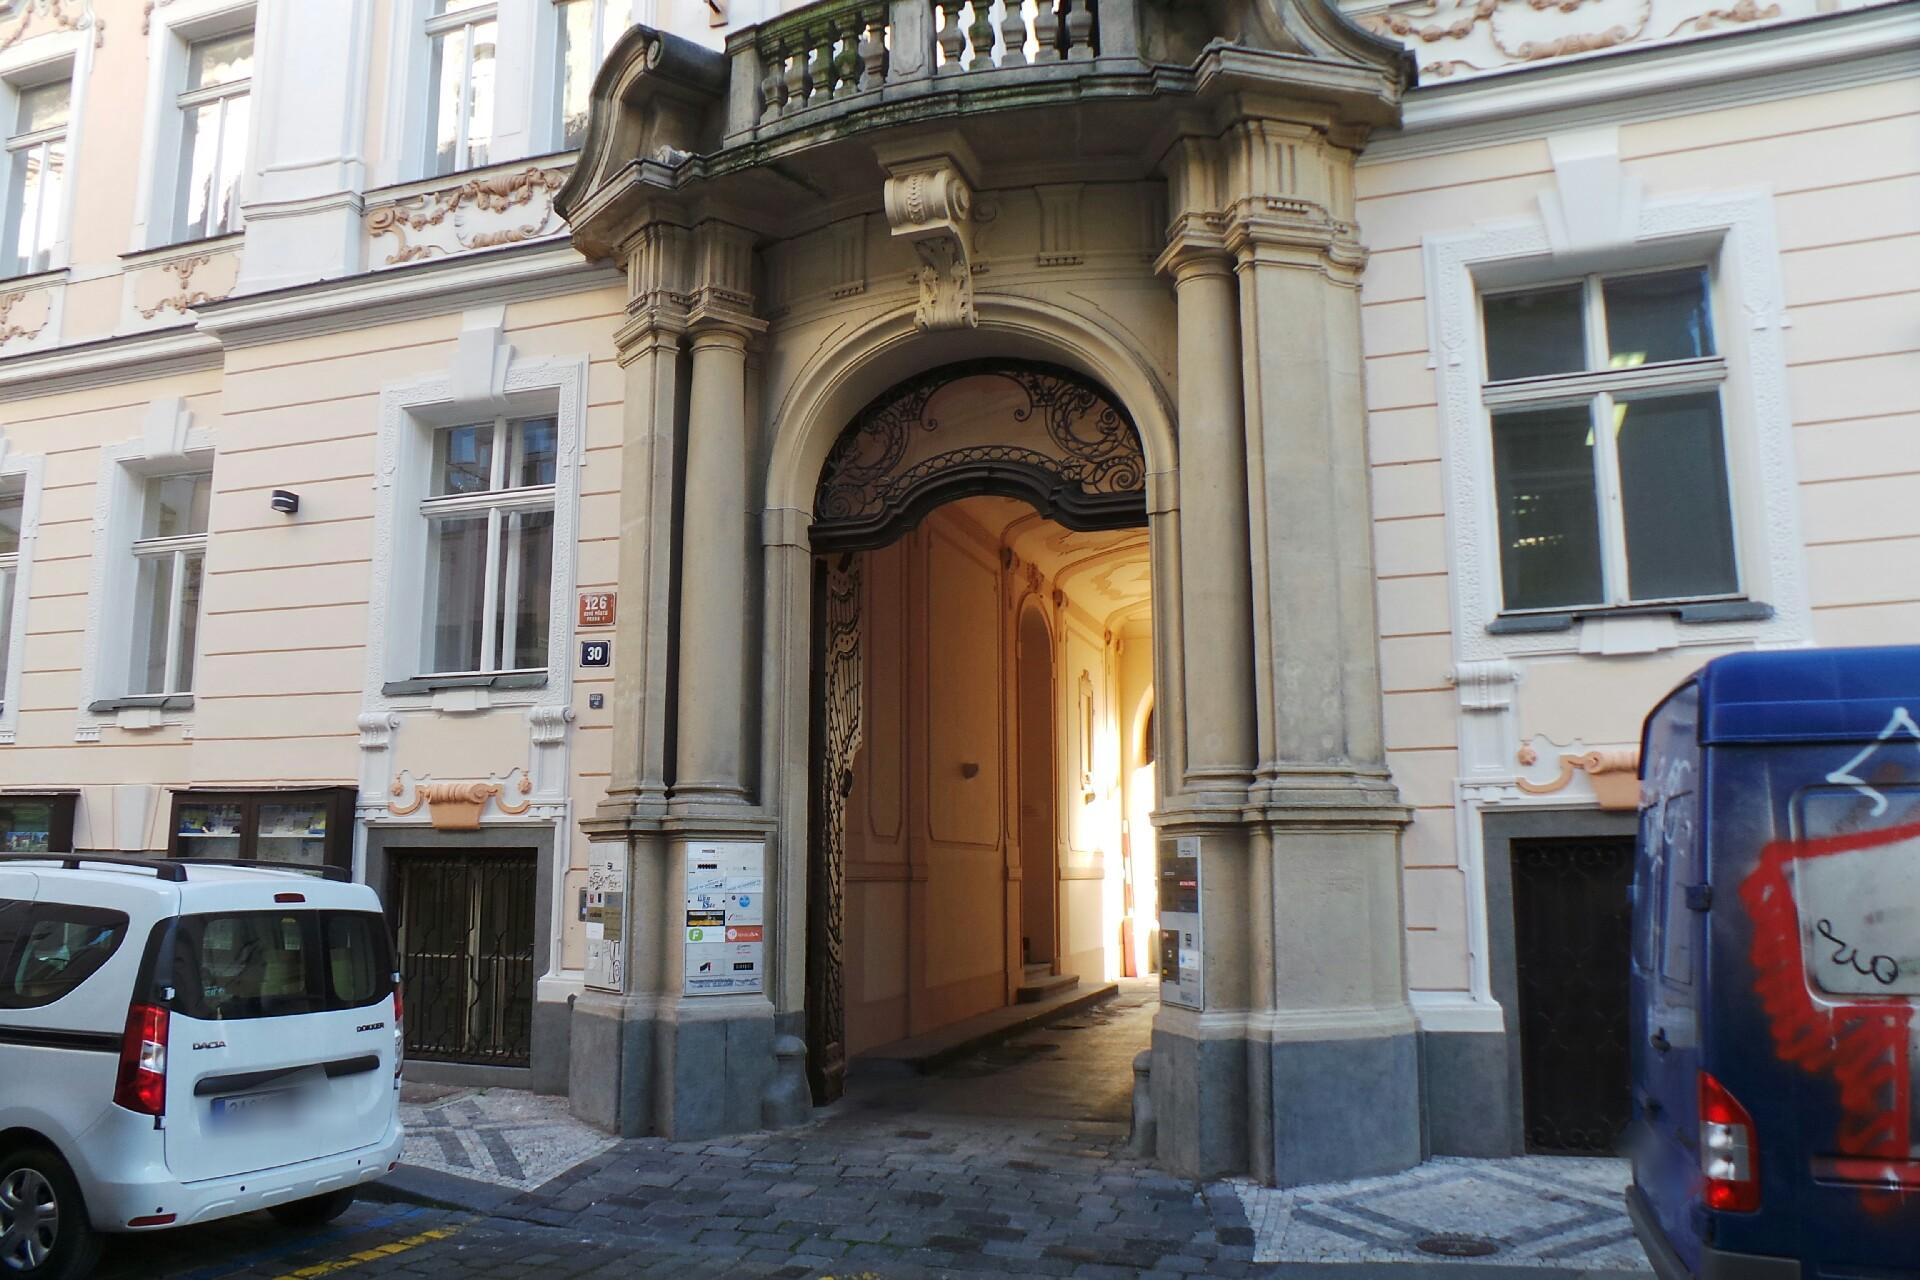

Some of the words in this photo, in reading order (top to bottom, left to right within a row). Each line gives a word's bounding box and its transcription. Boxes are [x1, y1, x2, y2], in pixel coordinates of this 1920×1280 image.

[585, 597, 607, 610] 126
[587, 646, 602, 661] 30
[356, 1022, 385, 1033] DOKKER
[192, 1041, 226, 1050] DACIA
